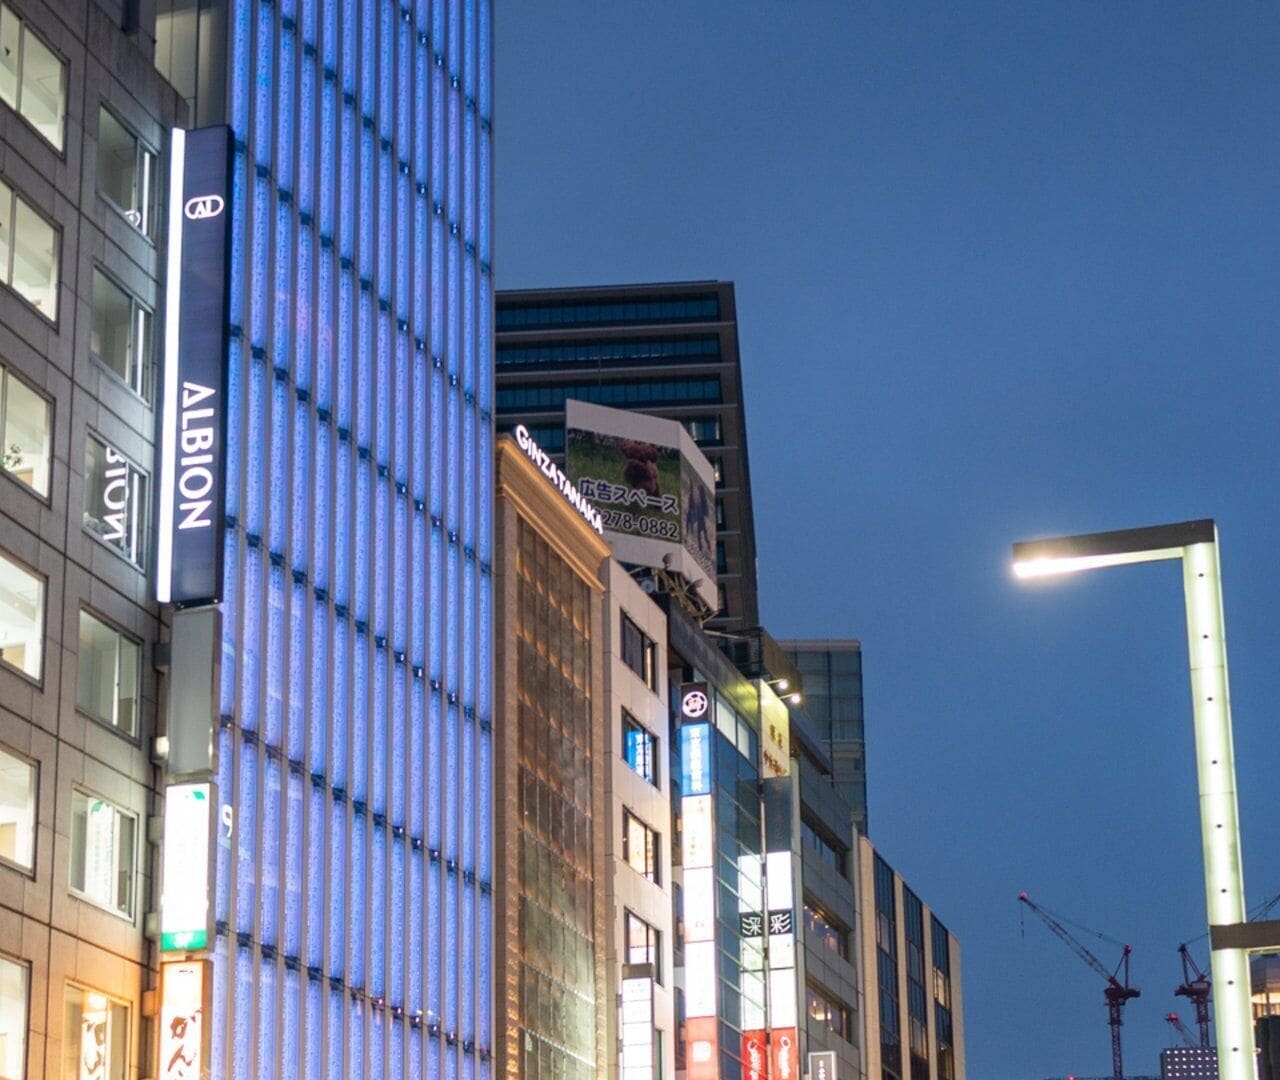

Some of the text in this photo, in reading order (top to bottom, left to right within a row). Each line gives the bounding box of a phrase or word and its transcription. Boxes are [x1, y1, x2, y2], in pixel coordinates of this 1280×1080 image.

[178, 382, 215, 529] ALBION
[516, 424, 603, 534] GINZATANAKA
[579, 476, 680, 515] 広告スペース
[596, 508, 680, 539] 278-0882
